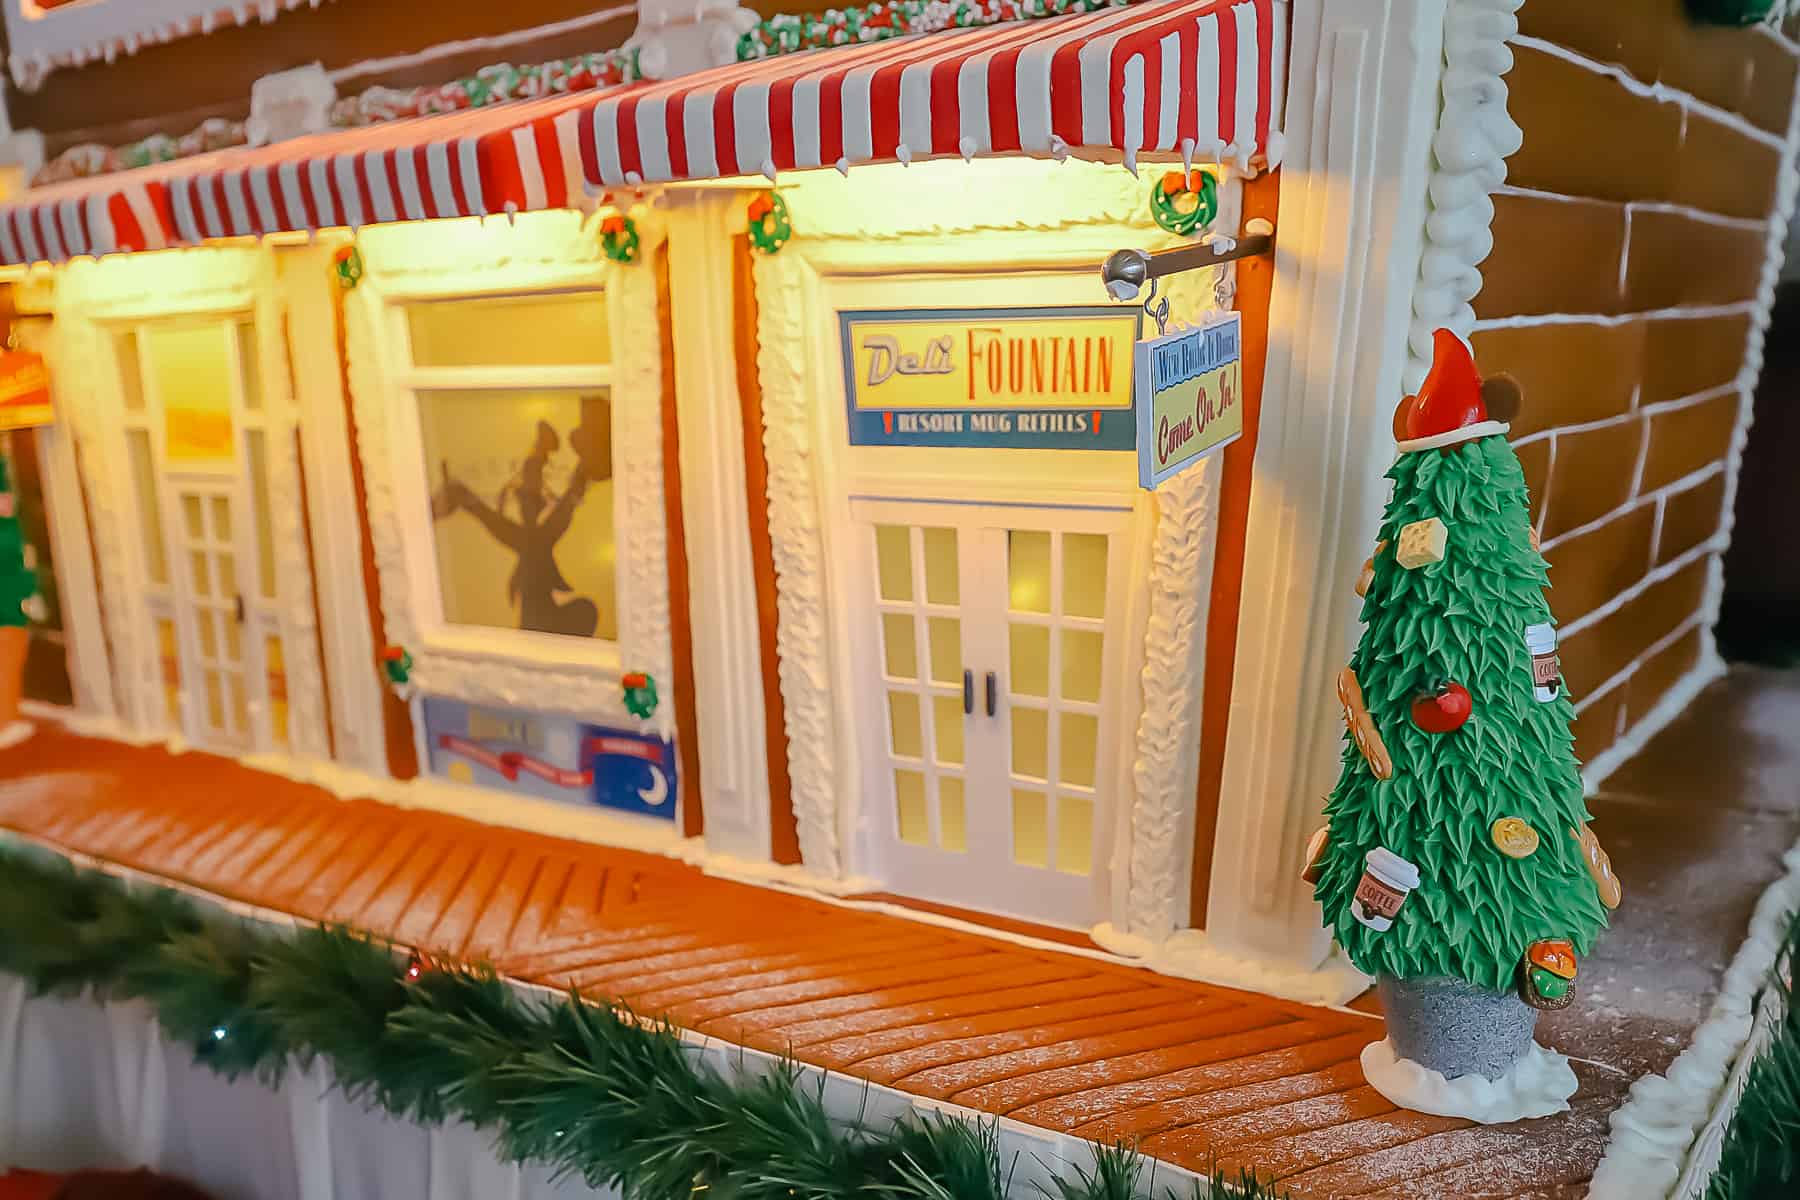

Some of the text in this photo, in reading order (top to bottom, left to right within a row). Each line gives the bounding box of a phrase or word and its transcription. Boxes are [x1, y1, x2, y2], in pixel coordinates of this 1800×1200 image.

[863, 335, 955, 386] Deli
[967, 328, 1113, 400] FOUNTAIN
[898, 413, 964, 432] RESORT
[970, 413, 1011, 432] MUG
[1158, 415, 1194, 464] Come
[1196, 386, 1215, 433] On
